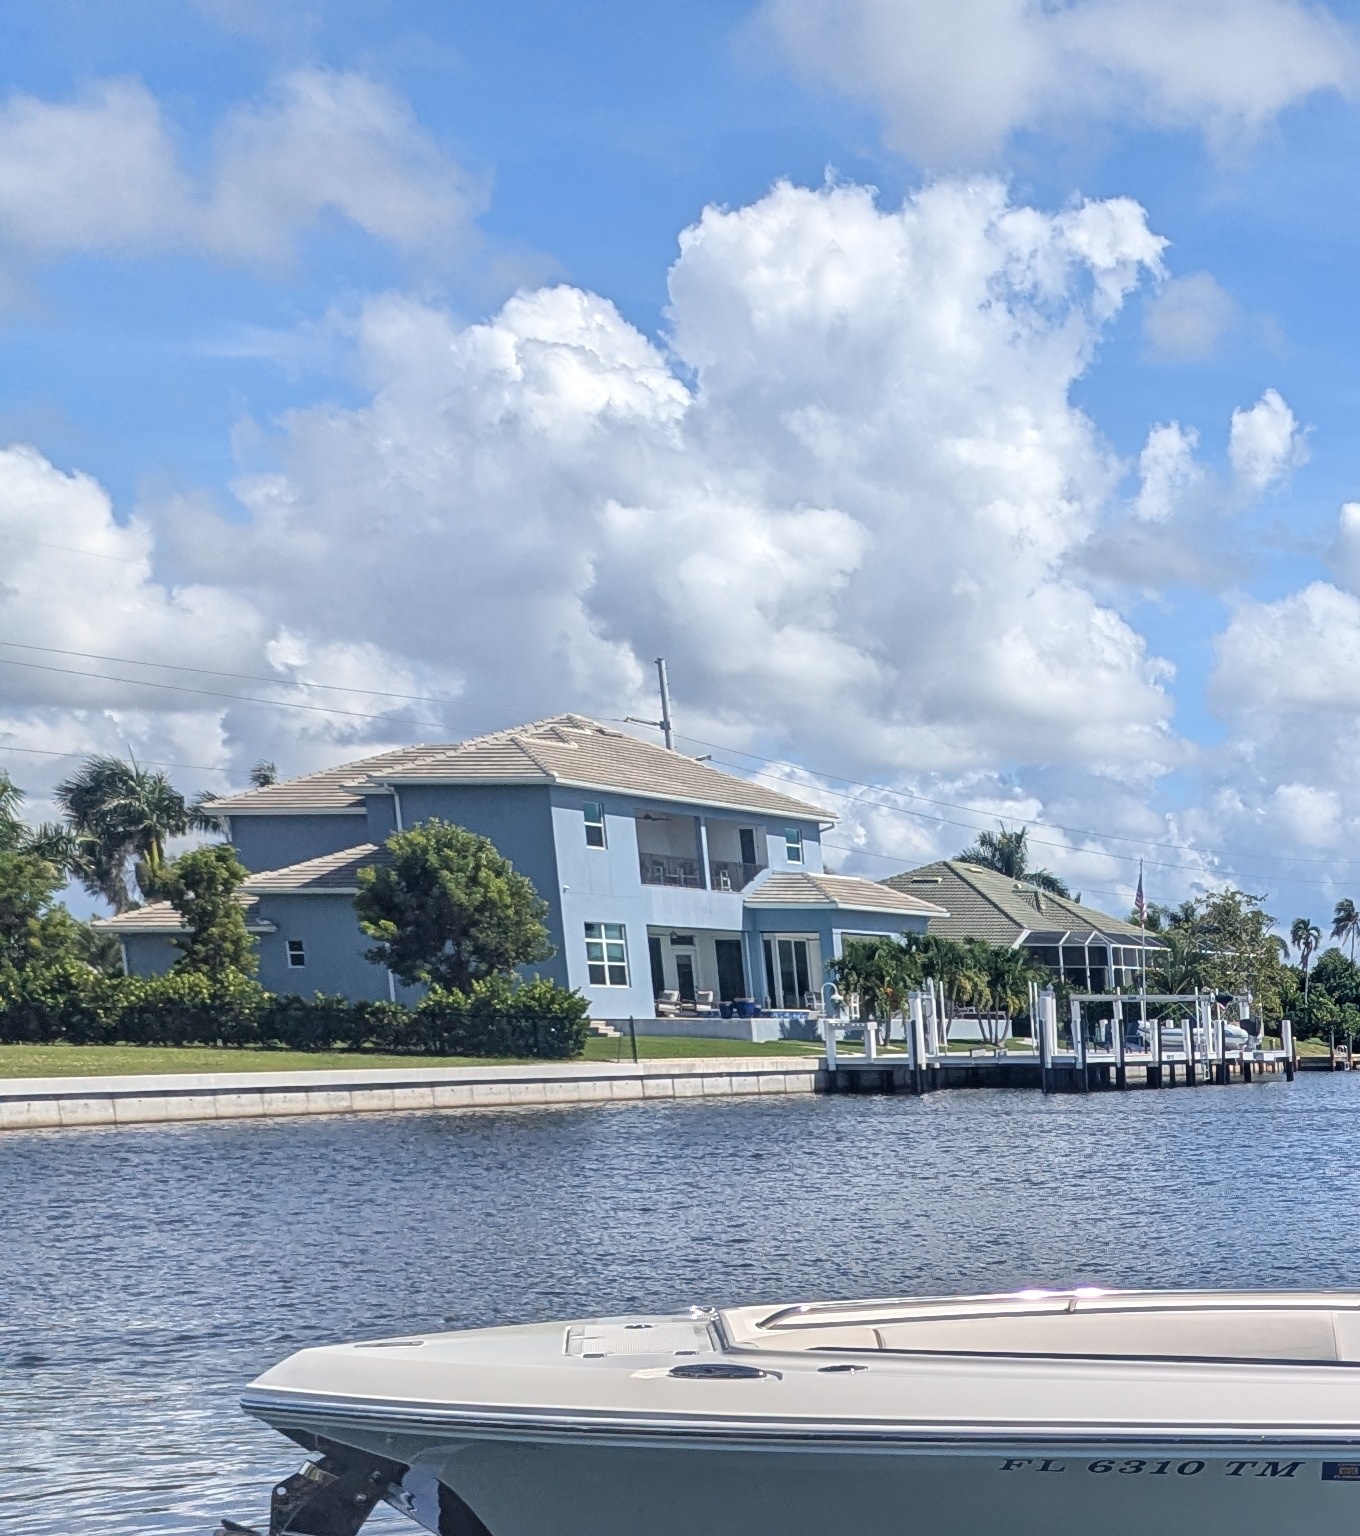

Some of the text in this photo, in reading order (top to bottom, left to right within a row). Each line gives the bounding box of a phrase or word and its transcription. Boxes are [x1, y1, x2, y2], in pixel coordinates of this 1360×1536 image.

[998, 1458, 1306, 1477] FL 6310 TM
